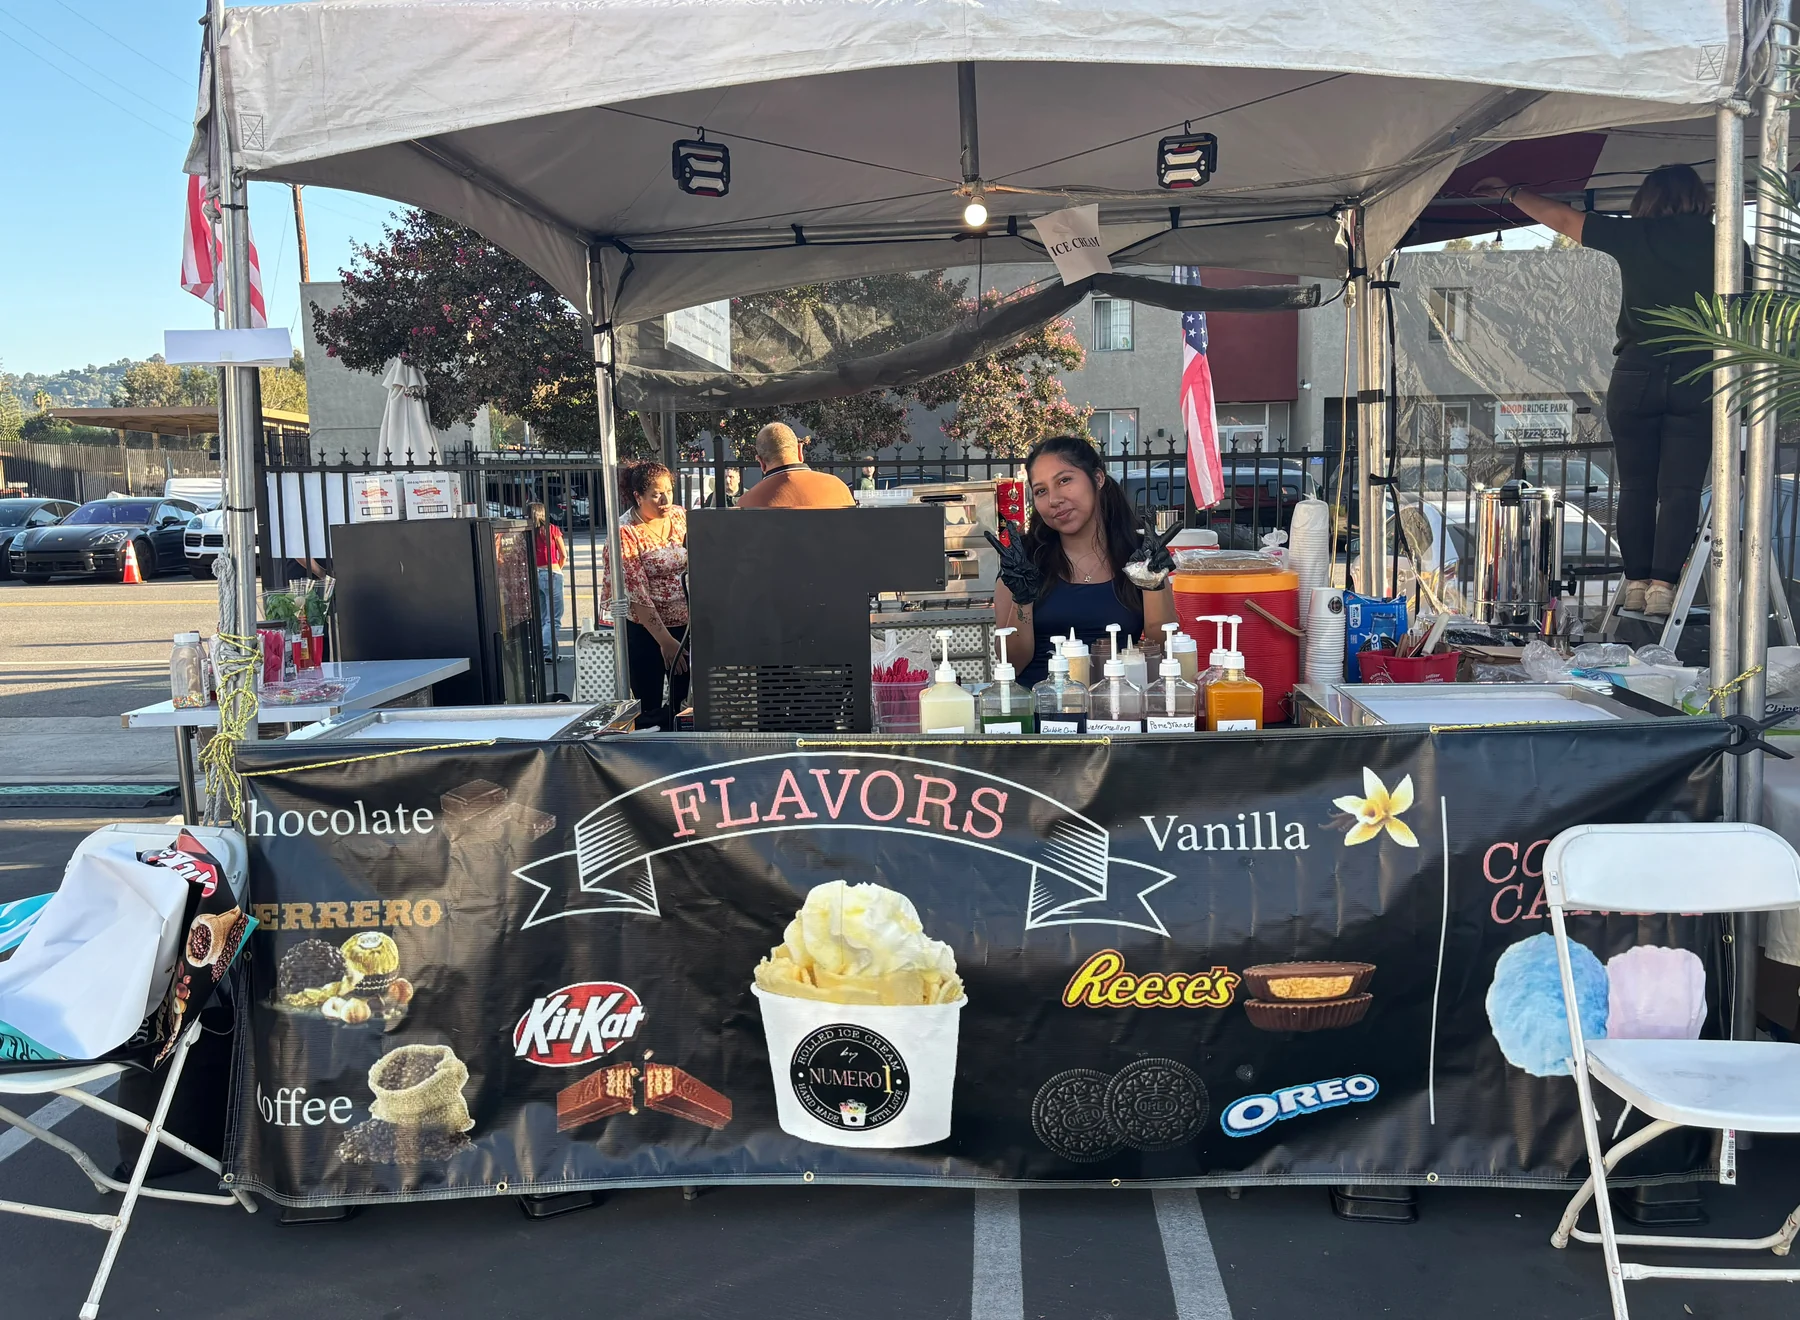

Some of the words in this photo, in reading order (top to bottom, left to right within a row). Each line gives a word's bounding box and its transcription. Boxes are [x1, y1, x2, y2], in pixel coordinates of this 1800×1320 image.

[1050, 241, 1072, 257] ICE
[1072, 236, 1100, 249] CREAM
[1500, 403, 1548, 413] WOODBRIDGE
[1550, 403, 1568, 413] PARK
[1765, 703, 1800, 714] Chine
[246, 799, 435, 837] hocolate
[660, 768, 1009, 839] FLAVORS
[1139, 811, 1311, 852] Vanilla
[252, 899, 443, 931] ERRERO
[1064, 951, 1239, 1007] Reese's
[514, 992, 646, 1057] KitKat
[838, 1029, 860, 1039] ICE
[864, 1034, 901, 1071] CREAM
[840, 1046, 859, 1064] by
[798, 1082, 817, 1115] HAND
[814, 1105, 840, 1123] MADE
[869, 1110, 892, 1123] WITH
[890, 1089, 904, 1113] LOVE
[1139, 1099, 1173, 1112] OREO
[1226, 1075, 1376, 1131] OREO
